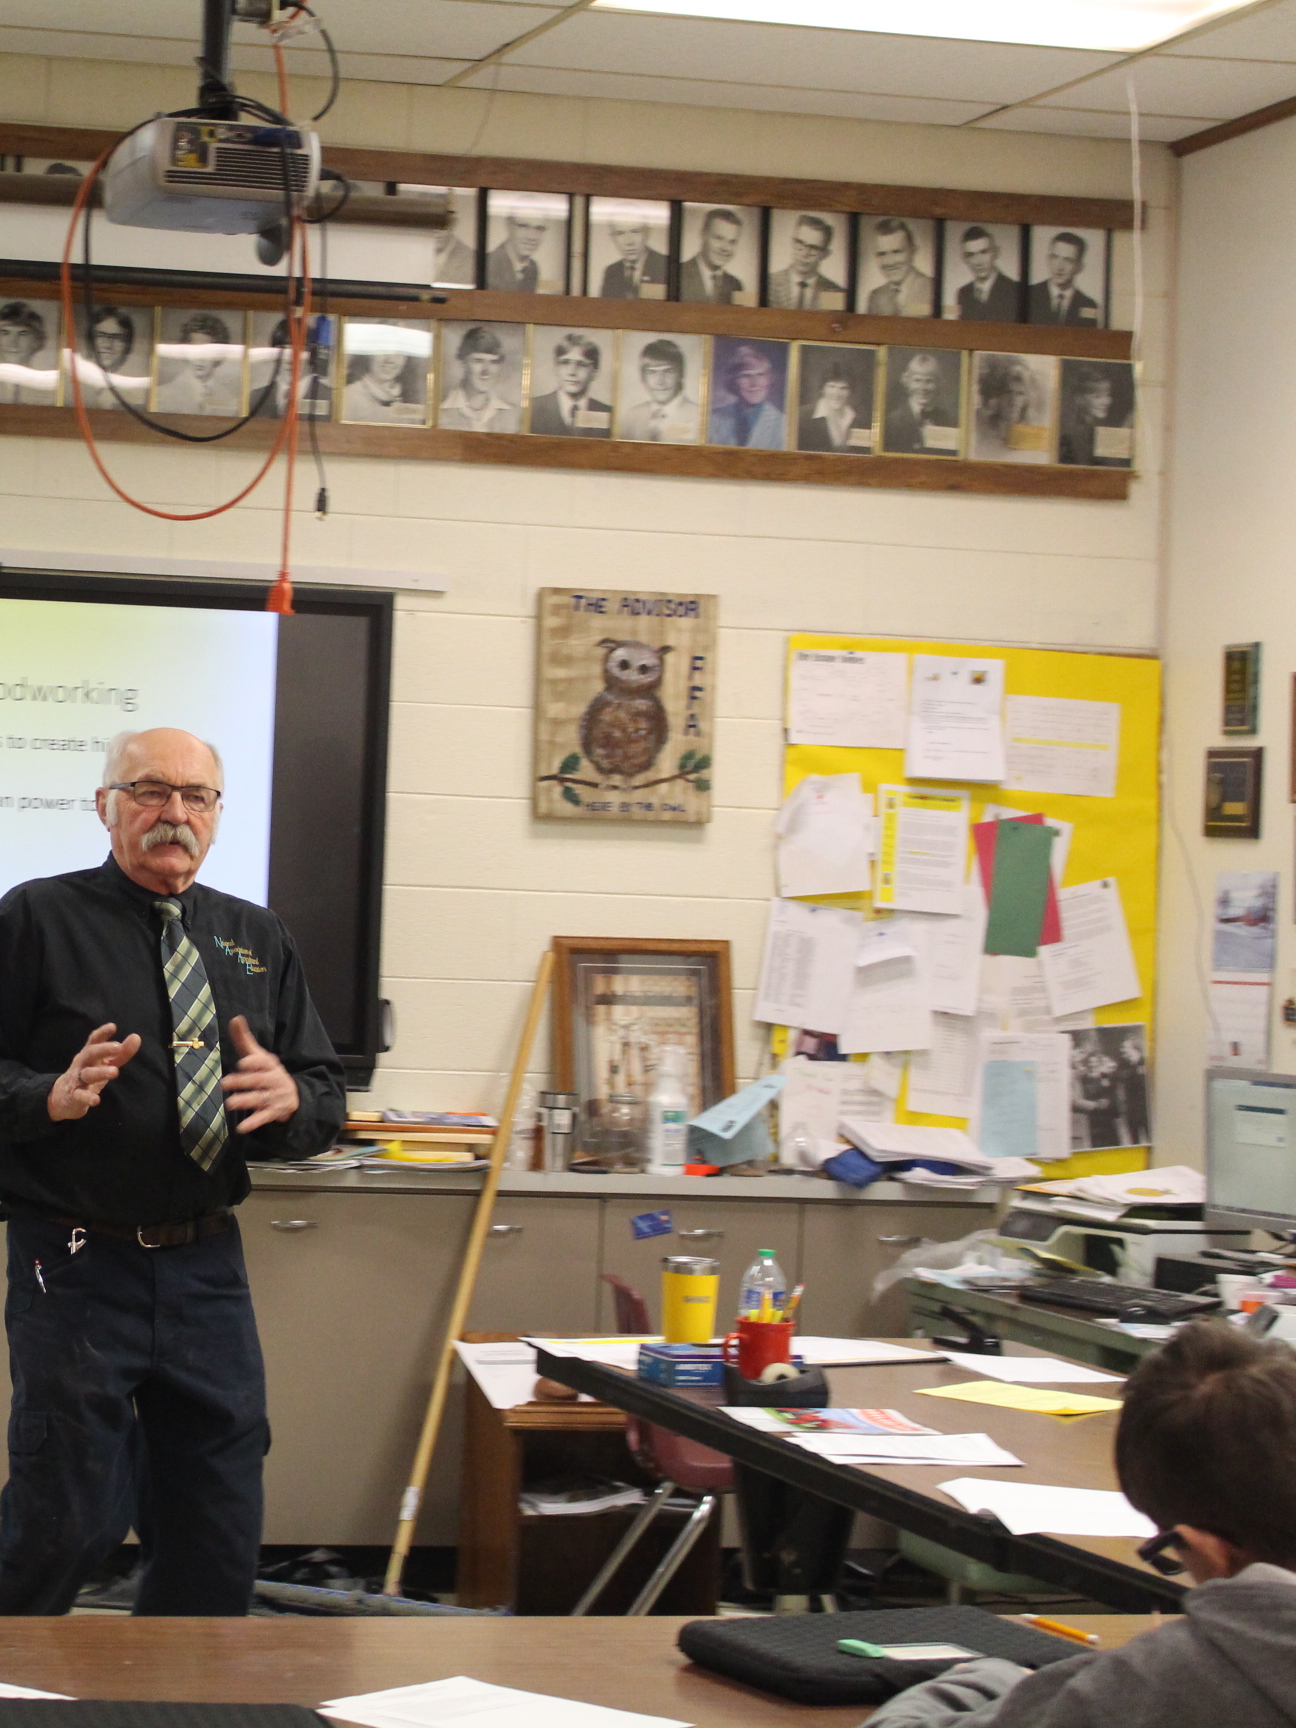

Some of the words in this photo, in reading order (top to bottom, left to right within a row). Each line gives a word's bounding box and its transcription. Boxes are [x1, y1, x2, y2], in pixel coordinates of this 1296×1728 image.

[571, 594, 608, 614] THE
[616, 597, 700, 619] ADVISOR
[7, 734, 26, 750] to
[29, 736, 88, 752] create
[18, 796, 77, 813] power
